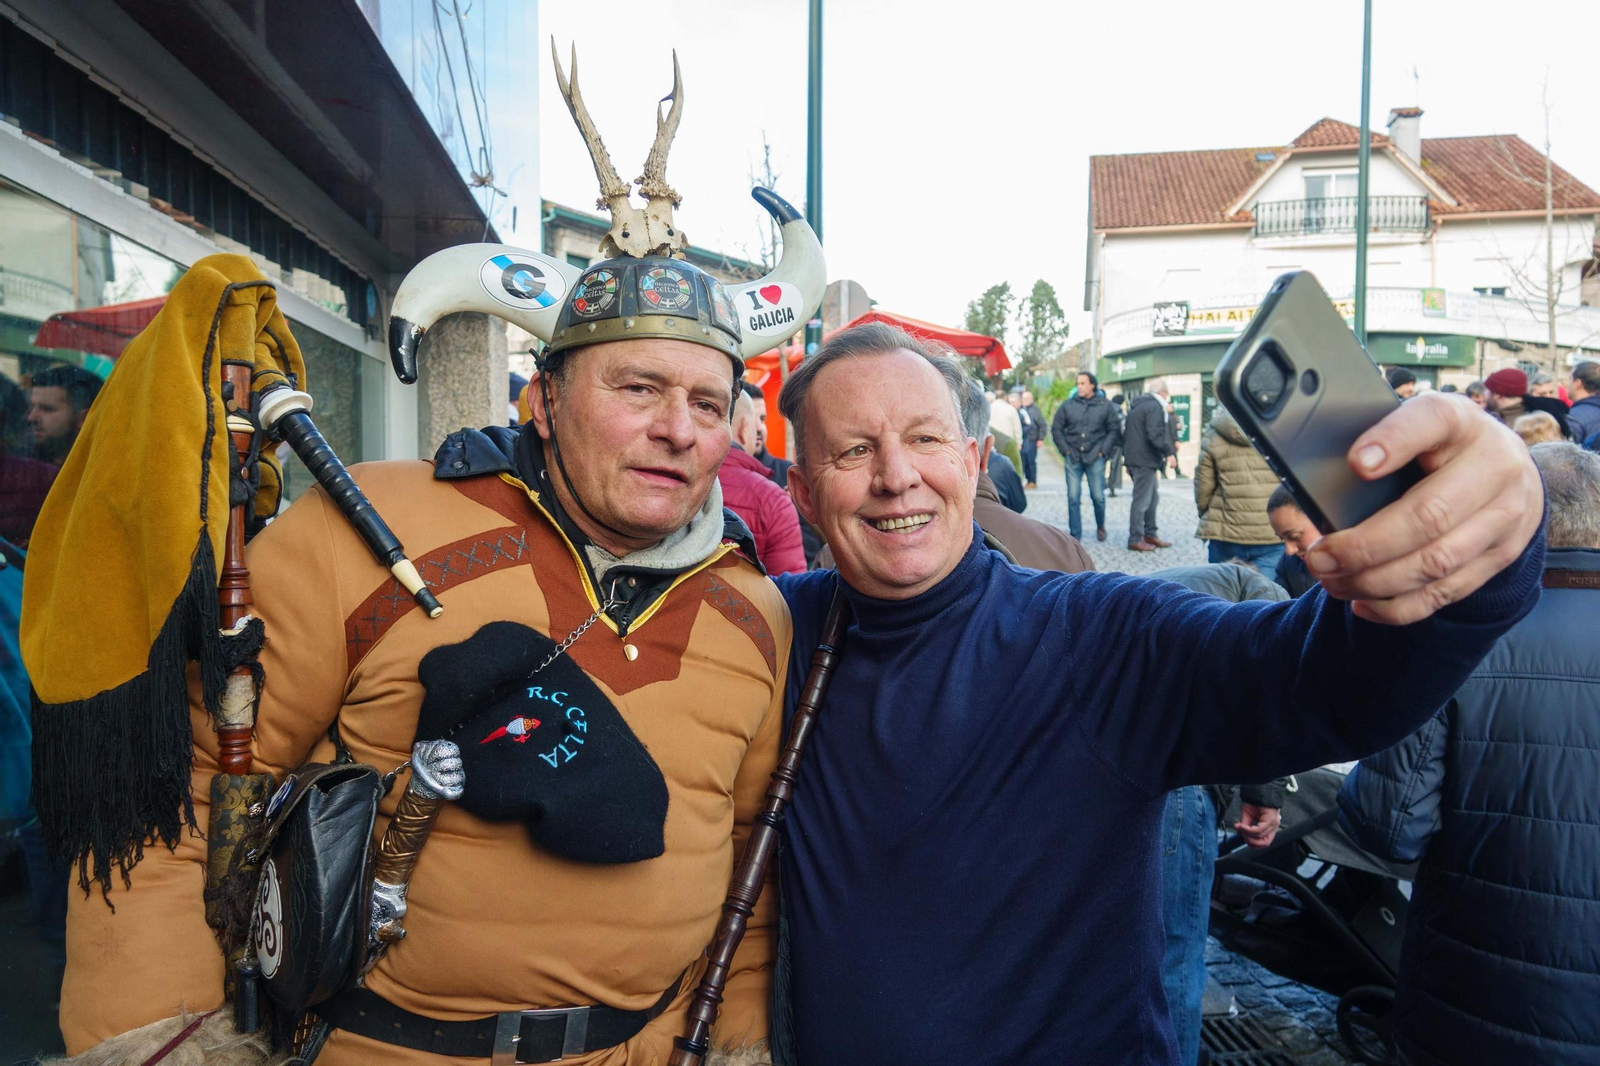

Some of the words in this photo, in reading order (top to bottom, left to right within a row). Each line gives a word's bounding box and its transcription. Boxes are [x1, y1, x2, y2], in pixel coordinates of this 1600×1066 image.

[501, 263, 546, 300] G
[746, 290, 764, 311] I
[749, 306, 795, 331] GALICIA
[538, 706, 588, 768] CELTA
